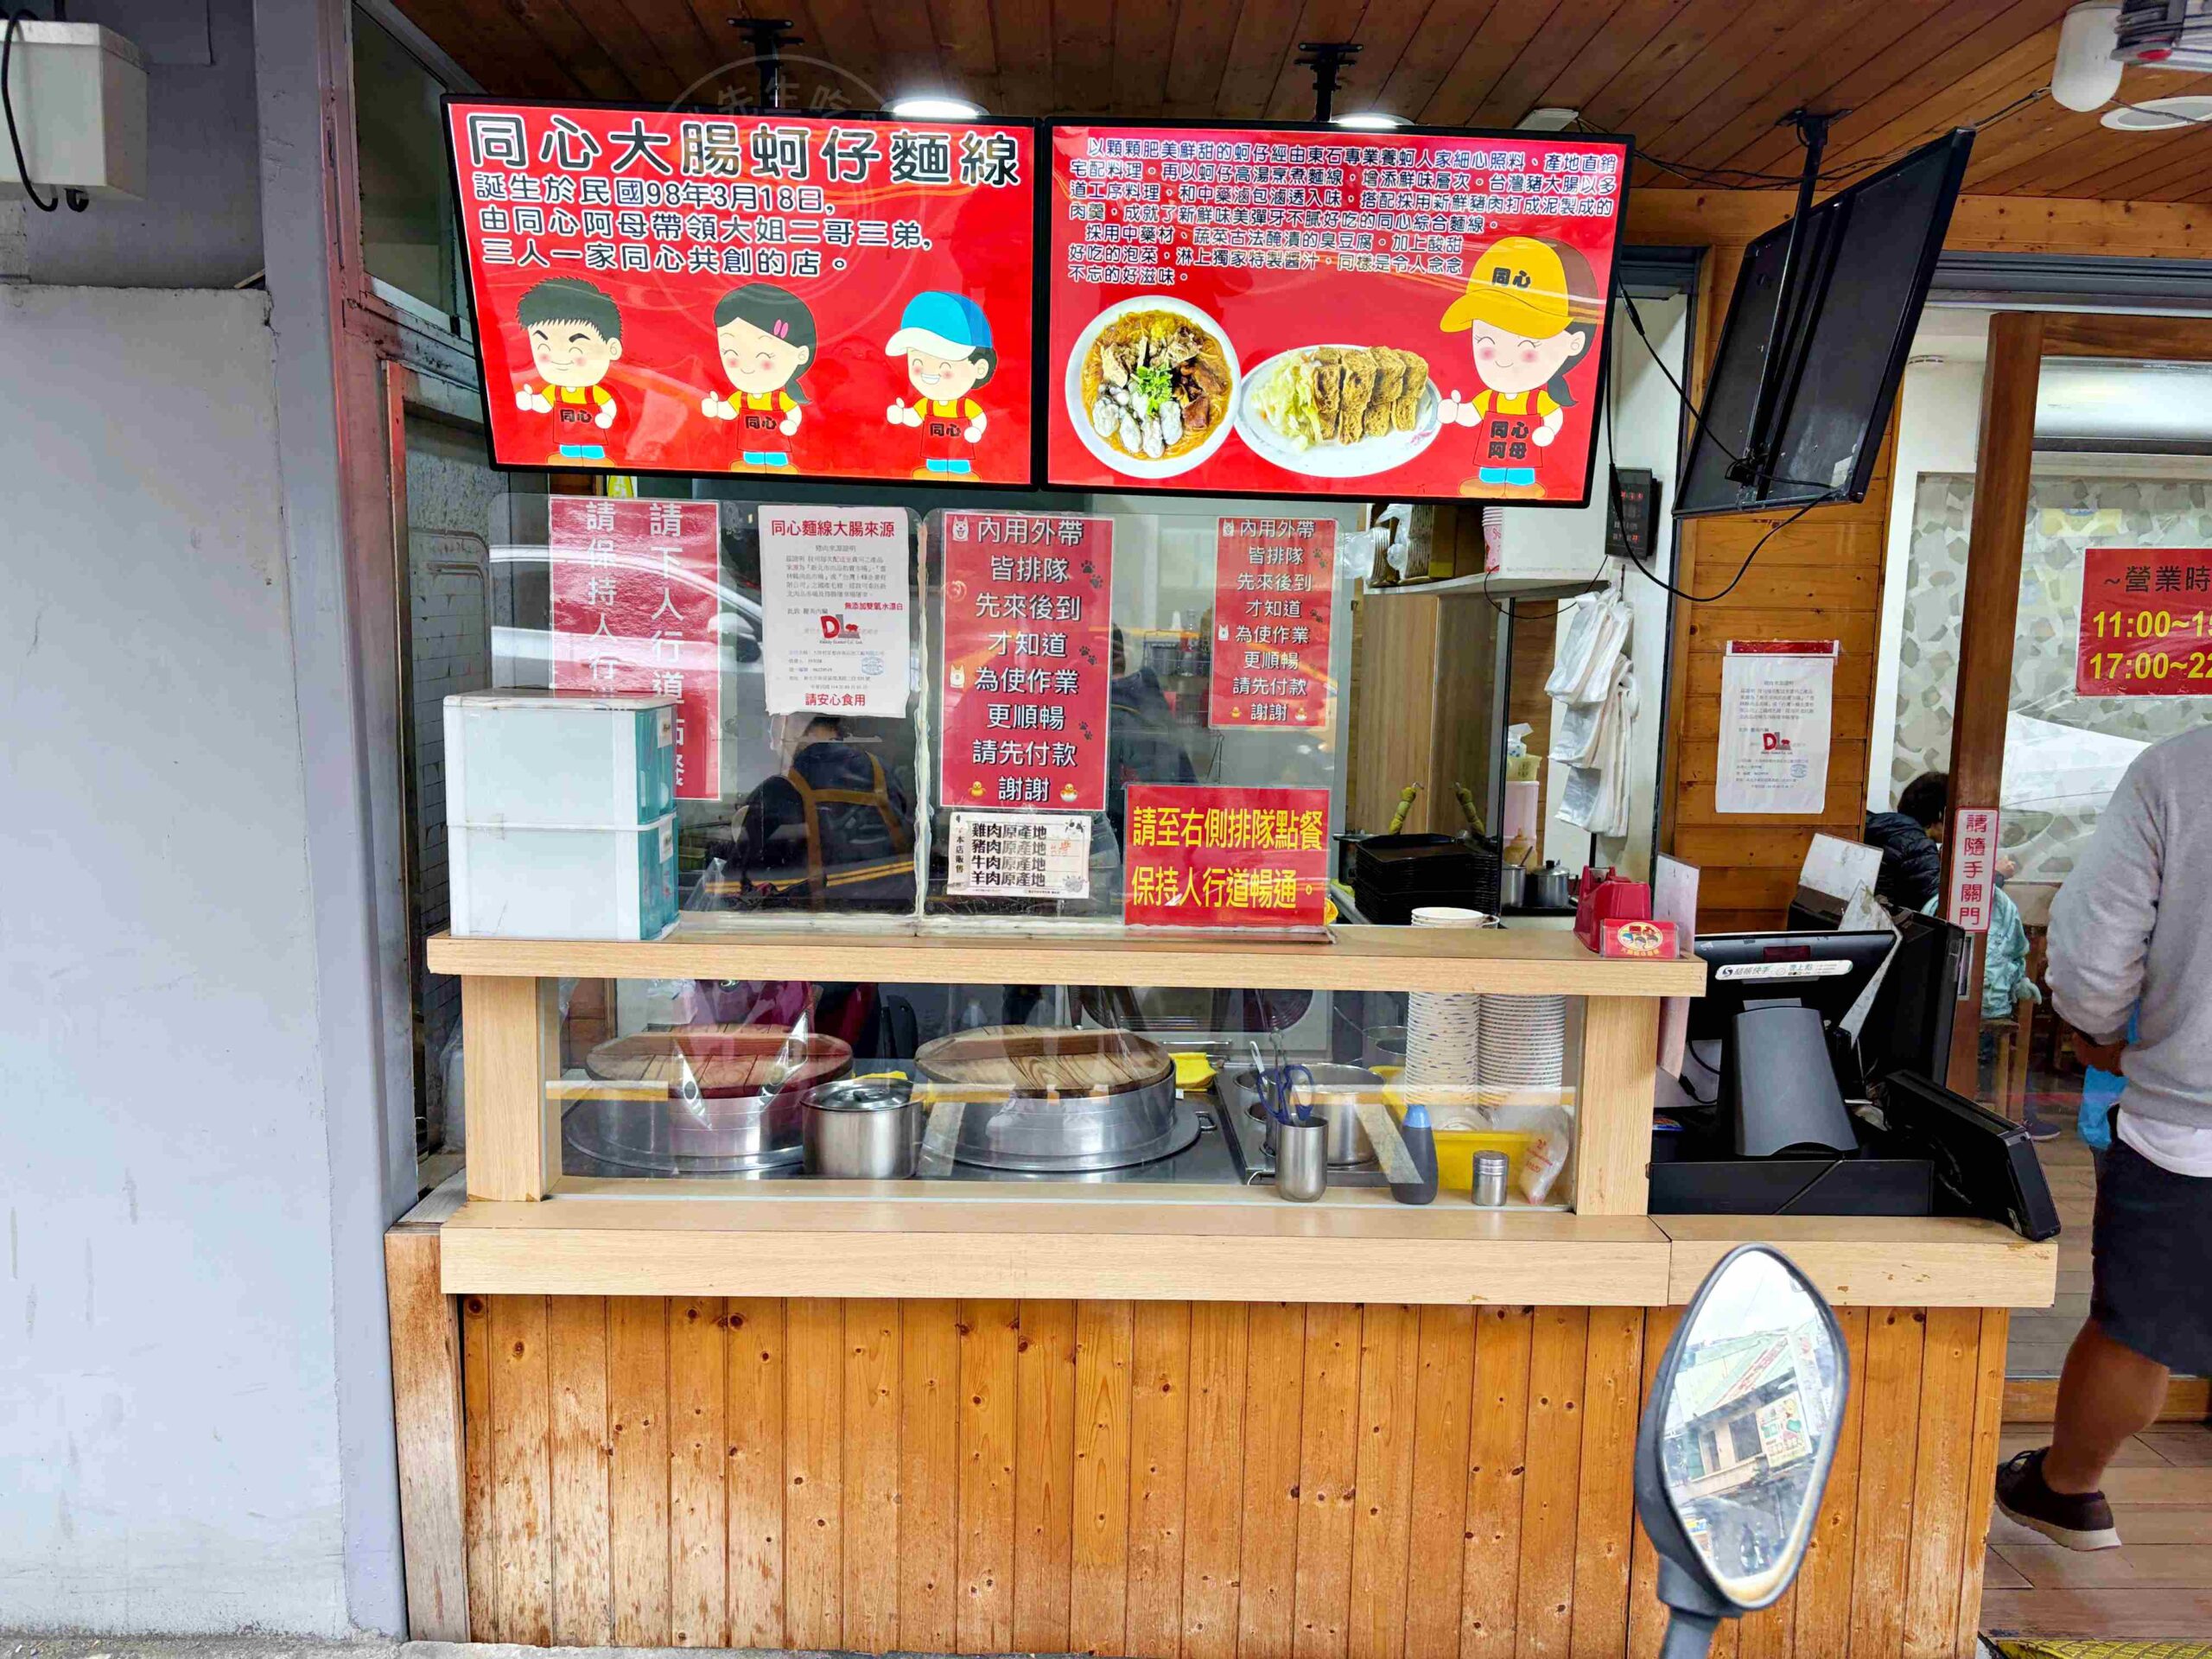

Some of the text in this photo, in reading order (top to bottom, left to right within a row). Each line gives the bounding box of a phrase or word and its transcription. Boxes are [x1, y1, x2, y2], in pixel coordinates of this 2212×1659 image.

[466, 112, 1022, 188] 同心大腸蚵仔麵線
[480, 238, 848, 277] 三人一家同心共創的店。
[1068, 265, 1188, 285] 不忘的好滋味。
[1491, 266, 1531, 289] 同心
[559, 408, 592, 423] 同心
[745, 415, 777, 431] 同心
[929, 422, 962, 438] 同心
[1490, 420, 1529, 439] 同心
[1488, 441, 1527, 460] 阿母
[772, 520, 895, 537] 同心麵線大腸來源
[977, 517, 1084, 547] 內用外帶
[1239, 519, 1315, 539] 內用外帶
[1249, 546, 1304, 565] 皆排隊
[990, 555, 1069, 584] 皆排隊
[1236, 573, 1313, 592] 先來後到
[586, 501, 617, 690] 請保持人行
[975, 593, 1081, 621] 先來後到
[1245, 600, 1301, 618] 才知道
[2093, 610, 2212, 638] 11:00~1
[988, 631, 1067, 658] 才知道
[1235, 625, 1309, 644] 為使作業
[648, 503, 685, 787] 請下人行道
[1243, 651, 1300, 671] 更順暢
[974, 666, 1078, 695] 為使作業
[1232, 677, 1307, 696] 請先付款
[805, 693, 866, 707] 請安心食用
[986, 703, 1065, 731] 更順暢
[1250, 702, 1287, 722] 謝謝
[972, 739, 1077, 766] 請先付款
[998, 776, 1050, 802] 謝謝
[971, 823, 1046, 840] 雞肉原產地
[1132, 805, 1323, 850] 請至右側排隊點餐
[955, 836, 965, 874] 本店販售
[971, 839, 1046, 856] 豬肉原產地
[971, 855, 1046, 872] 牛肉原產地
[1959, 814, 1988, 926] 請隨手關門
[971, 871, 1046, 887] 羊肉原產地
[1131, 865, 1313, 908] 保持人行道暢通。
